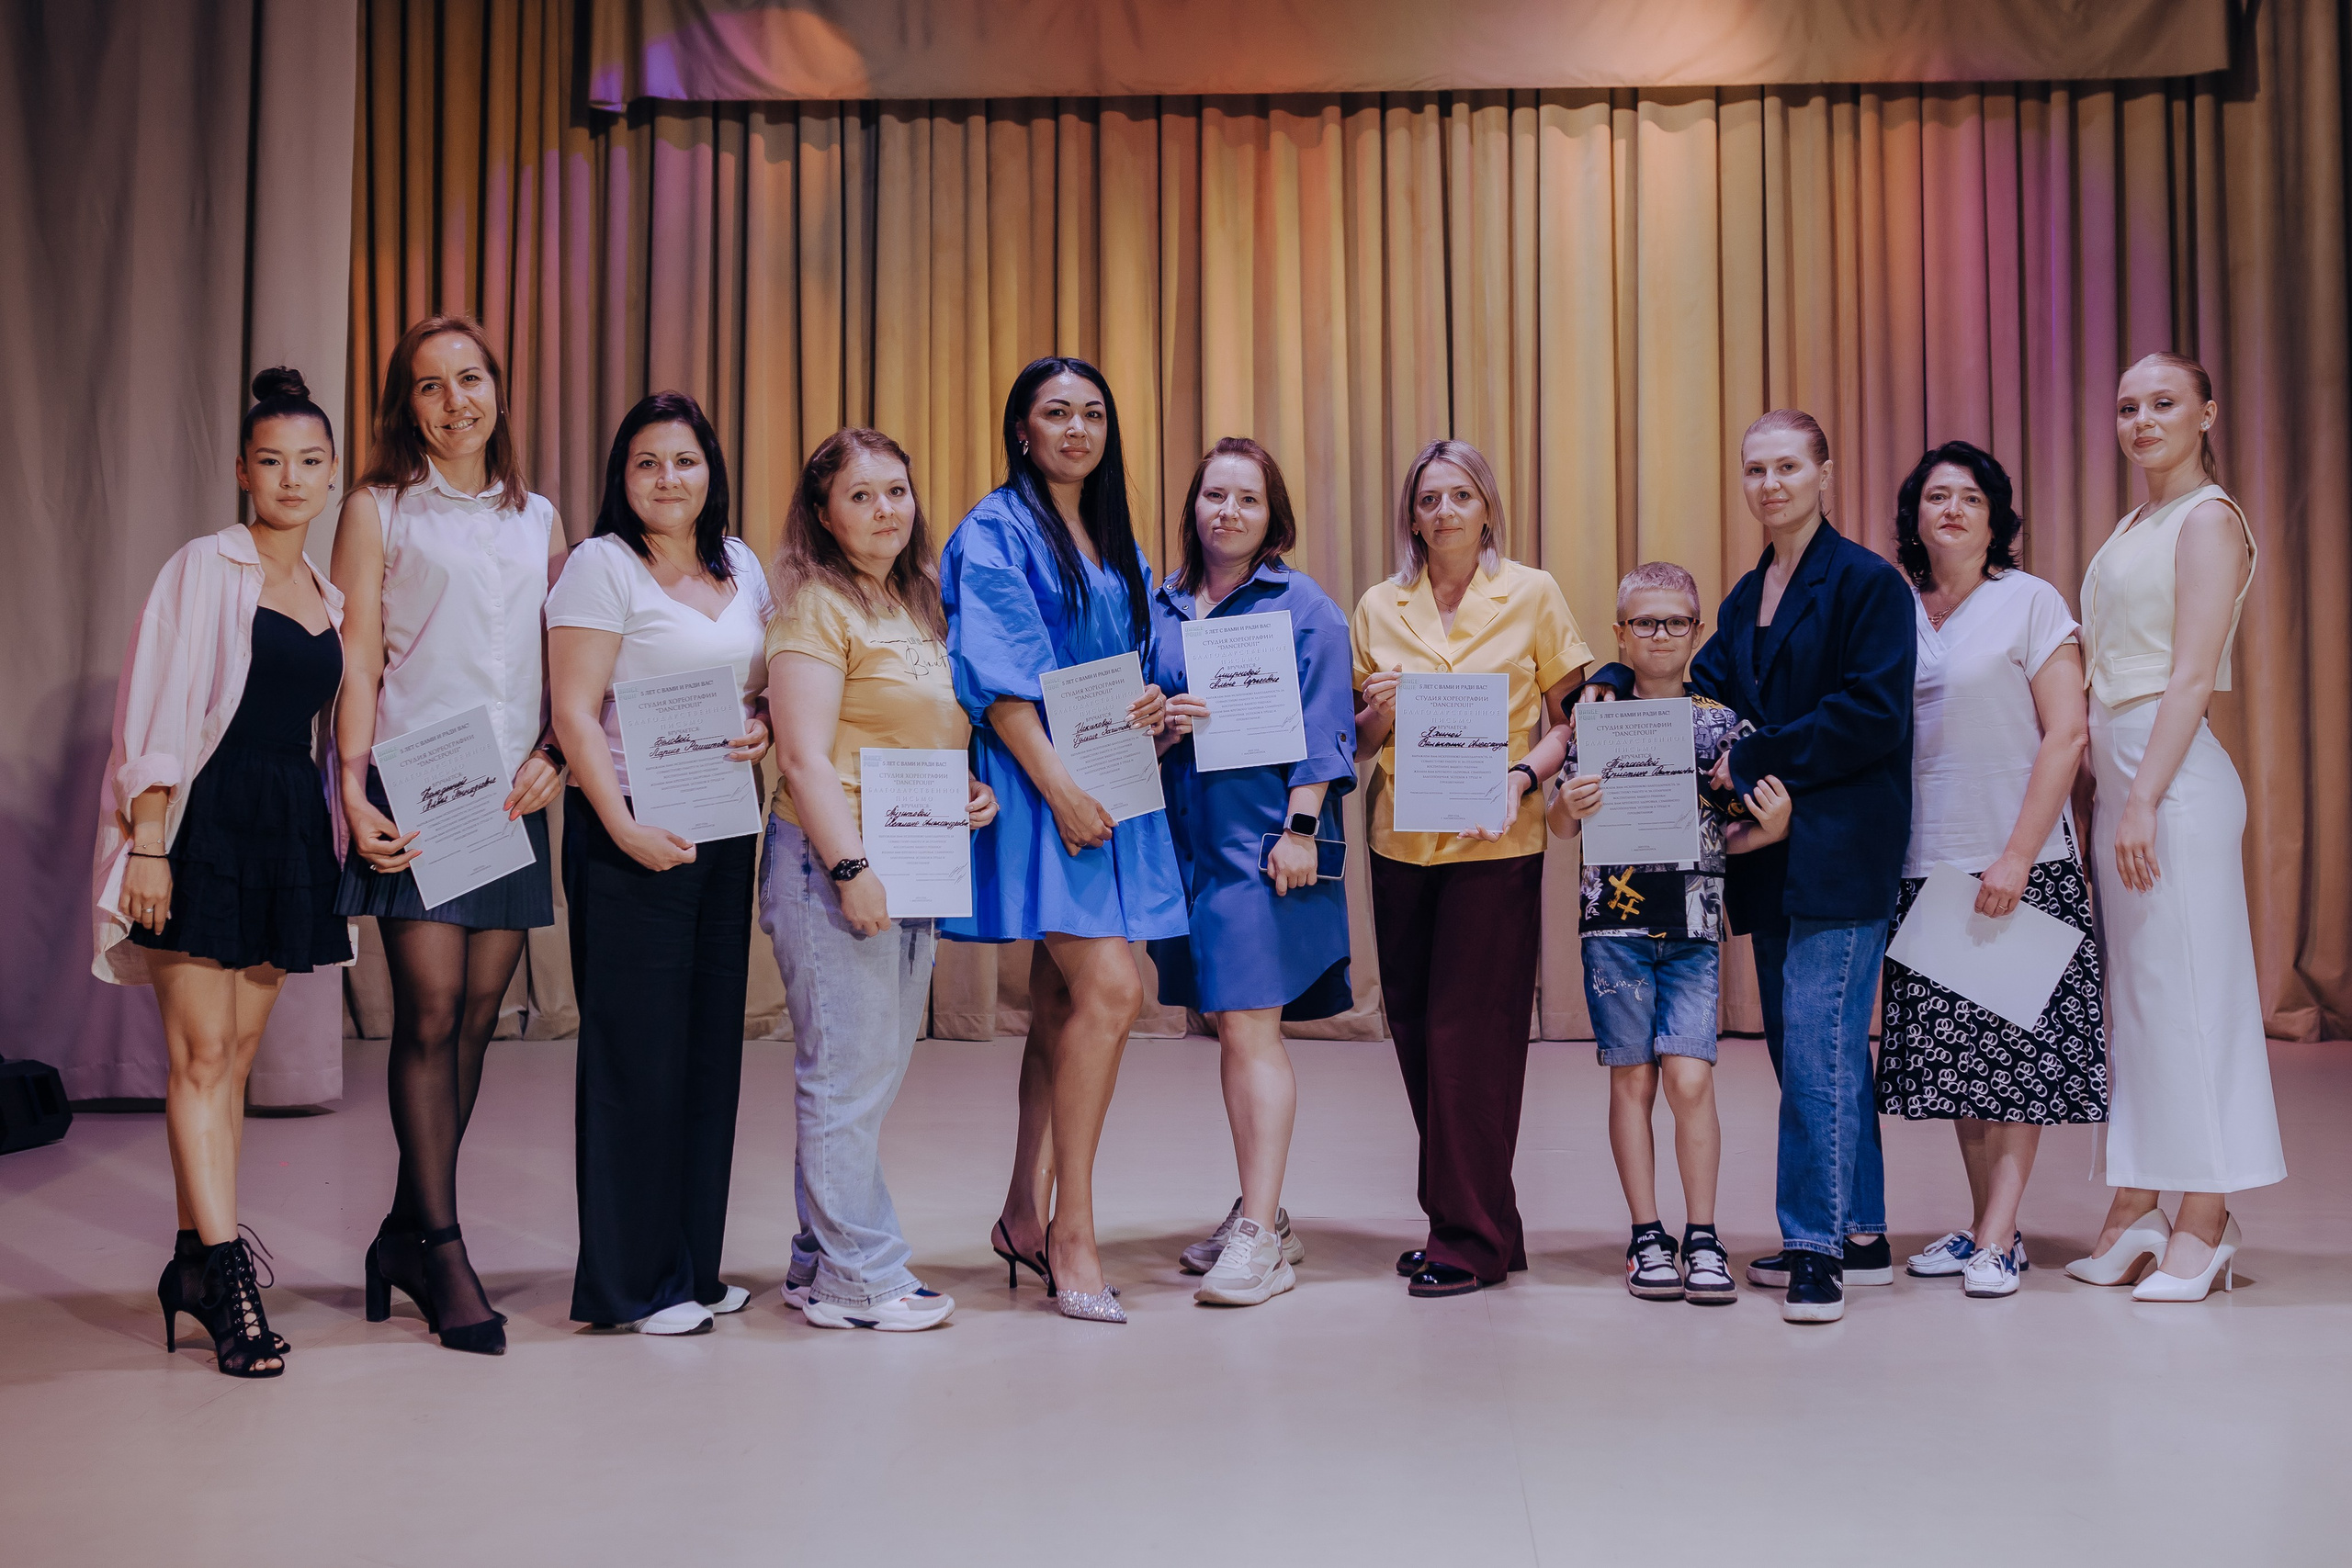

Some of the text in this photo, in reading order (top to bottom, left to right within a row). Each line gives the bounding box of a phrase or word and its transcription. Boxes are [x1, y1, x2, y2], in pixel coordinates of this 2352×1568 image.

[1229, 633, 1273, 643] ХОРЕОГРАФИИ
[1221, 656, 1260, 665] ПИСЬМО
[1061, 678, 1124, 699] СТУДИЯ ХОРЕОГРАФИИ
[639, 691, 717, 709] СТУДИЯ ХОРЕОГРАФИИ
[1080, 704, 1114, 717] ПИСЬМО
[660, 718, 703, 730] ПИСЬМО
[1625, 721, 1672, 730] ХОРЕОГРАФИИ
[404, 744, 415, 753] ЛЕТ
[420, 736, 436, 746] ВАМИ
[442, 728, 457, 737] РАДИ
[399, 733, 474, 768] СТУДИЯ ХОРЕОГРАФИИ
[649, 747, 680, 760] Ларисе
[424, 763, 465, 784] ПИСЬМО
[1637, 1234, 1655, 1243] FILA
